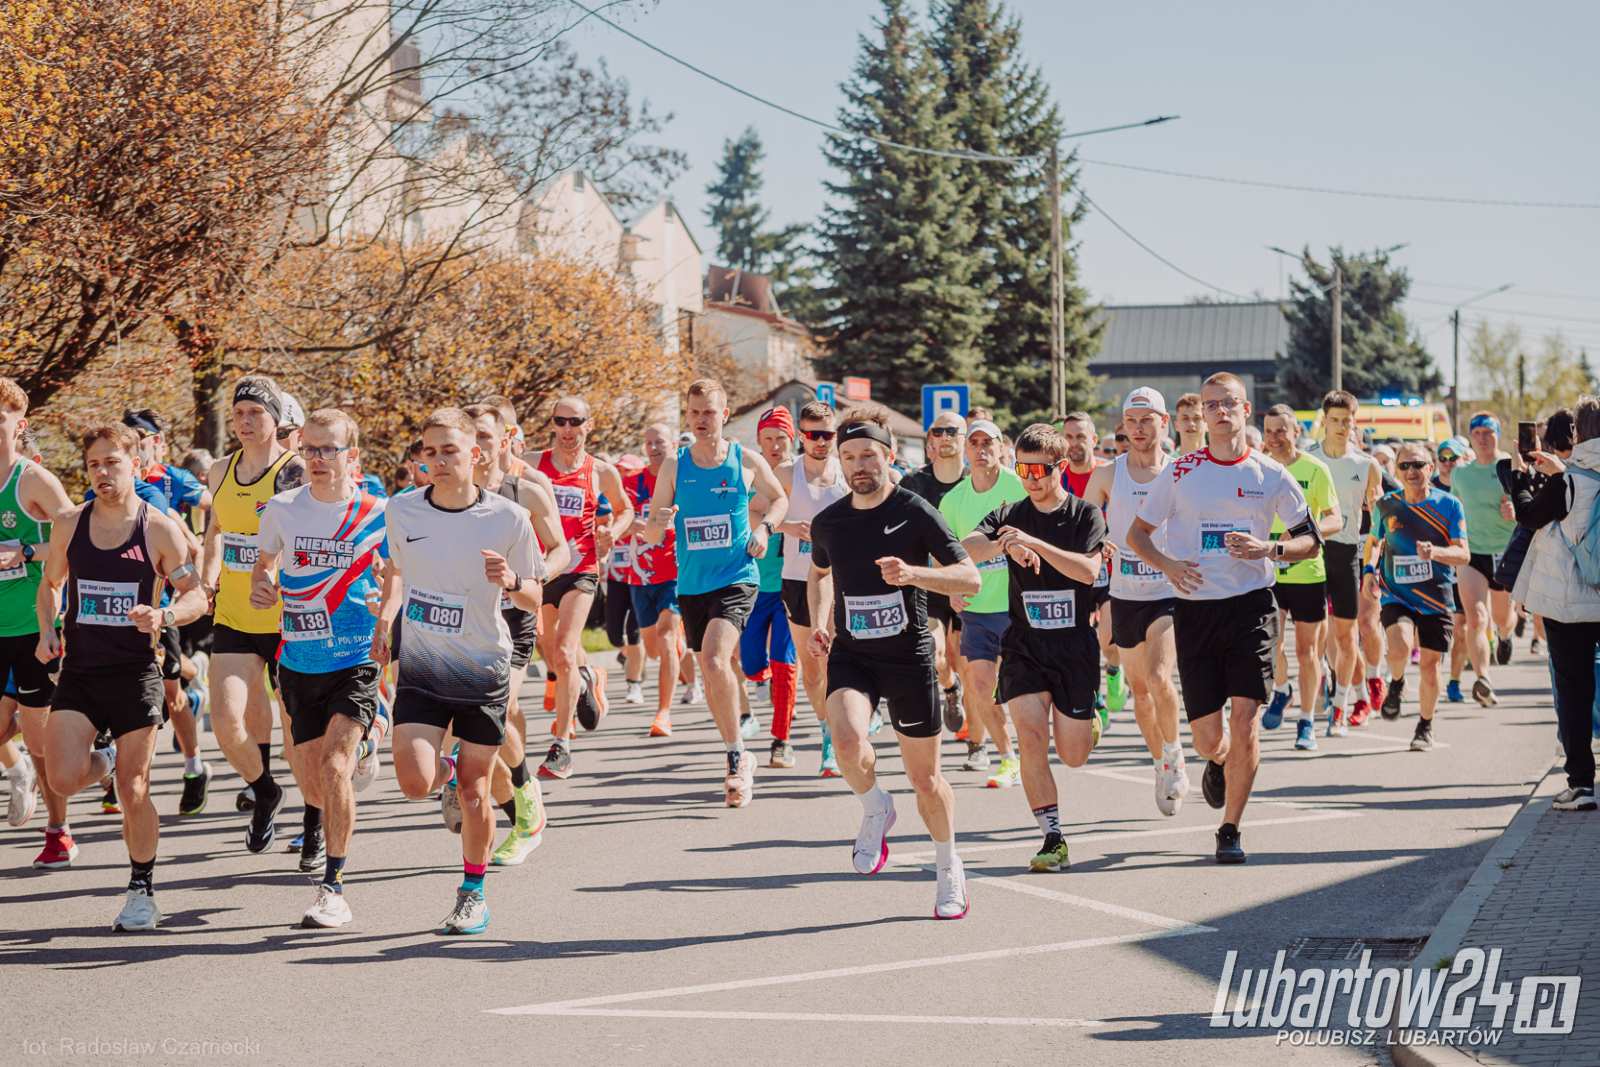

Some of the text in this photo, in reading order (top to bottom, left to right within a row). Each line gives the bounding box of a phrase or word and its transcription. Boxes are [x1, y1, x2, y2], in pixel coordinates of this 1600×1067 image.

[236, 386, 273, 404] RUN
[933, 390, 961, 421] P
[560, 496, 581, 509] 172
[704, 525, 727, 541] 097
[295, 537, 353, 554] NIEMCE
[310, 552, 353, 570] TEAM
[1410, 563, 1428, 576] 048
[103, 597, 133, 615] 139
[1045, 603, 1069, 618] 161
[298, 612, 327, 630] 138
[430, 606, 461, 626] 080
[872, 607, 901, 627] 123
